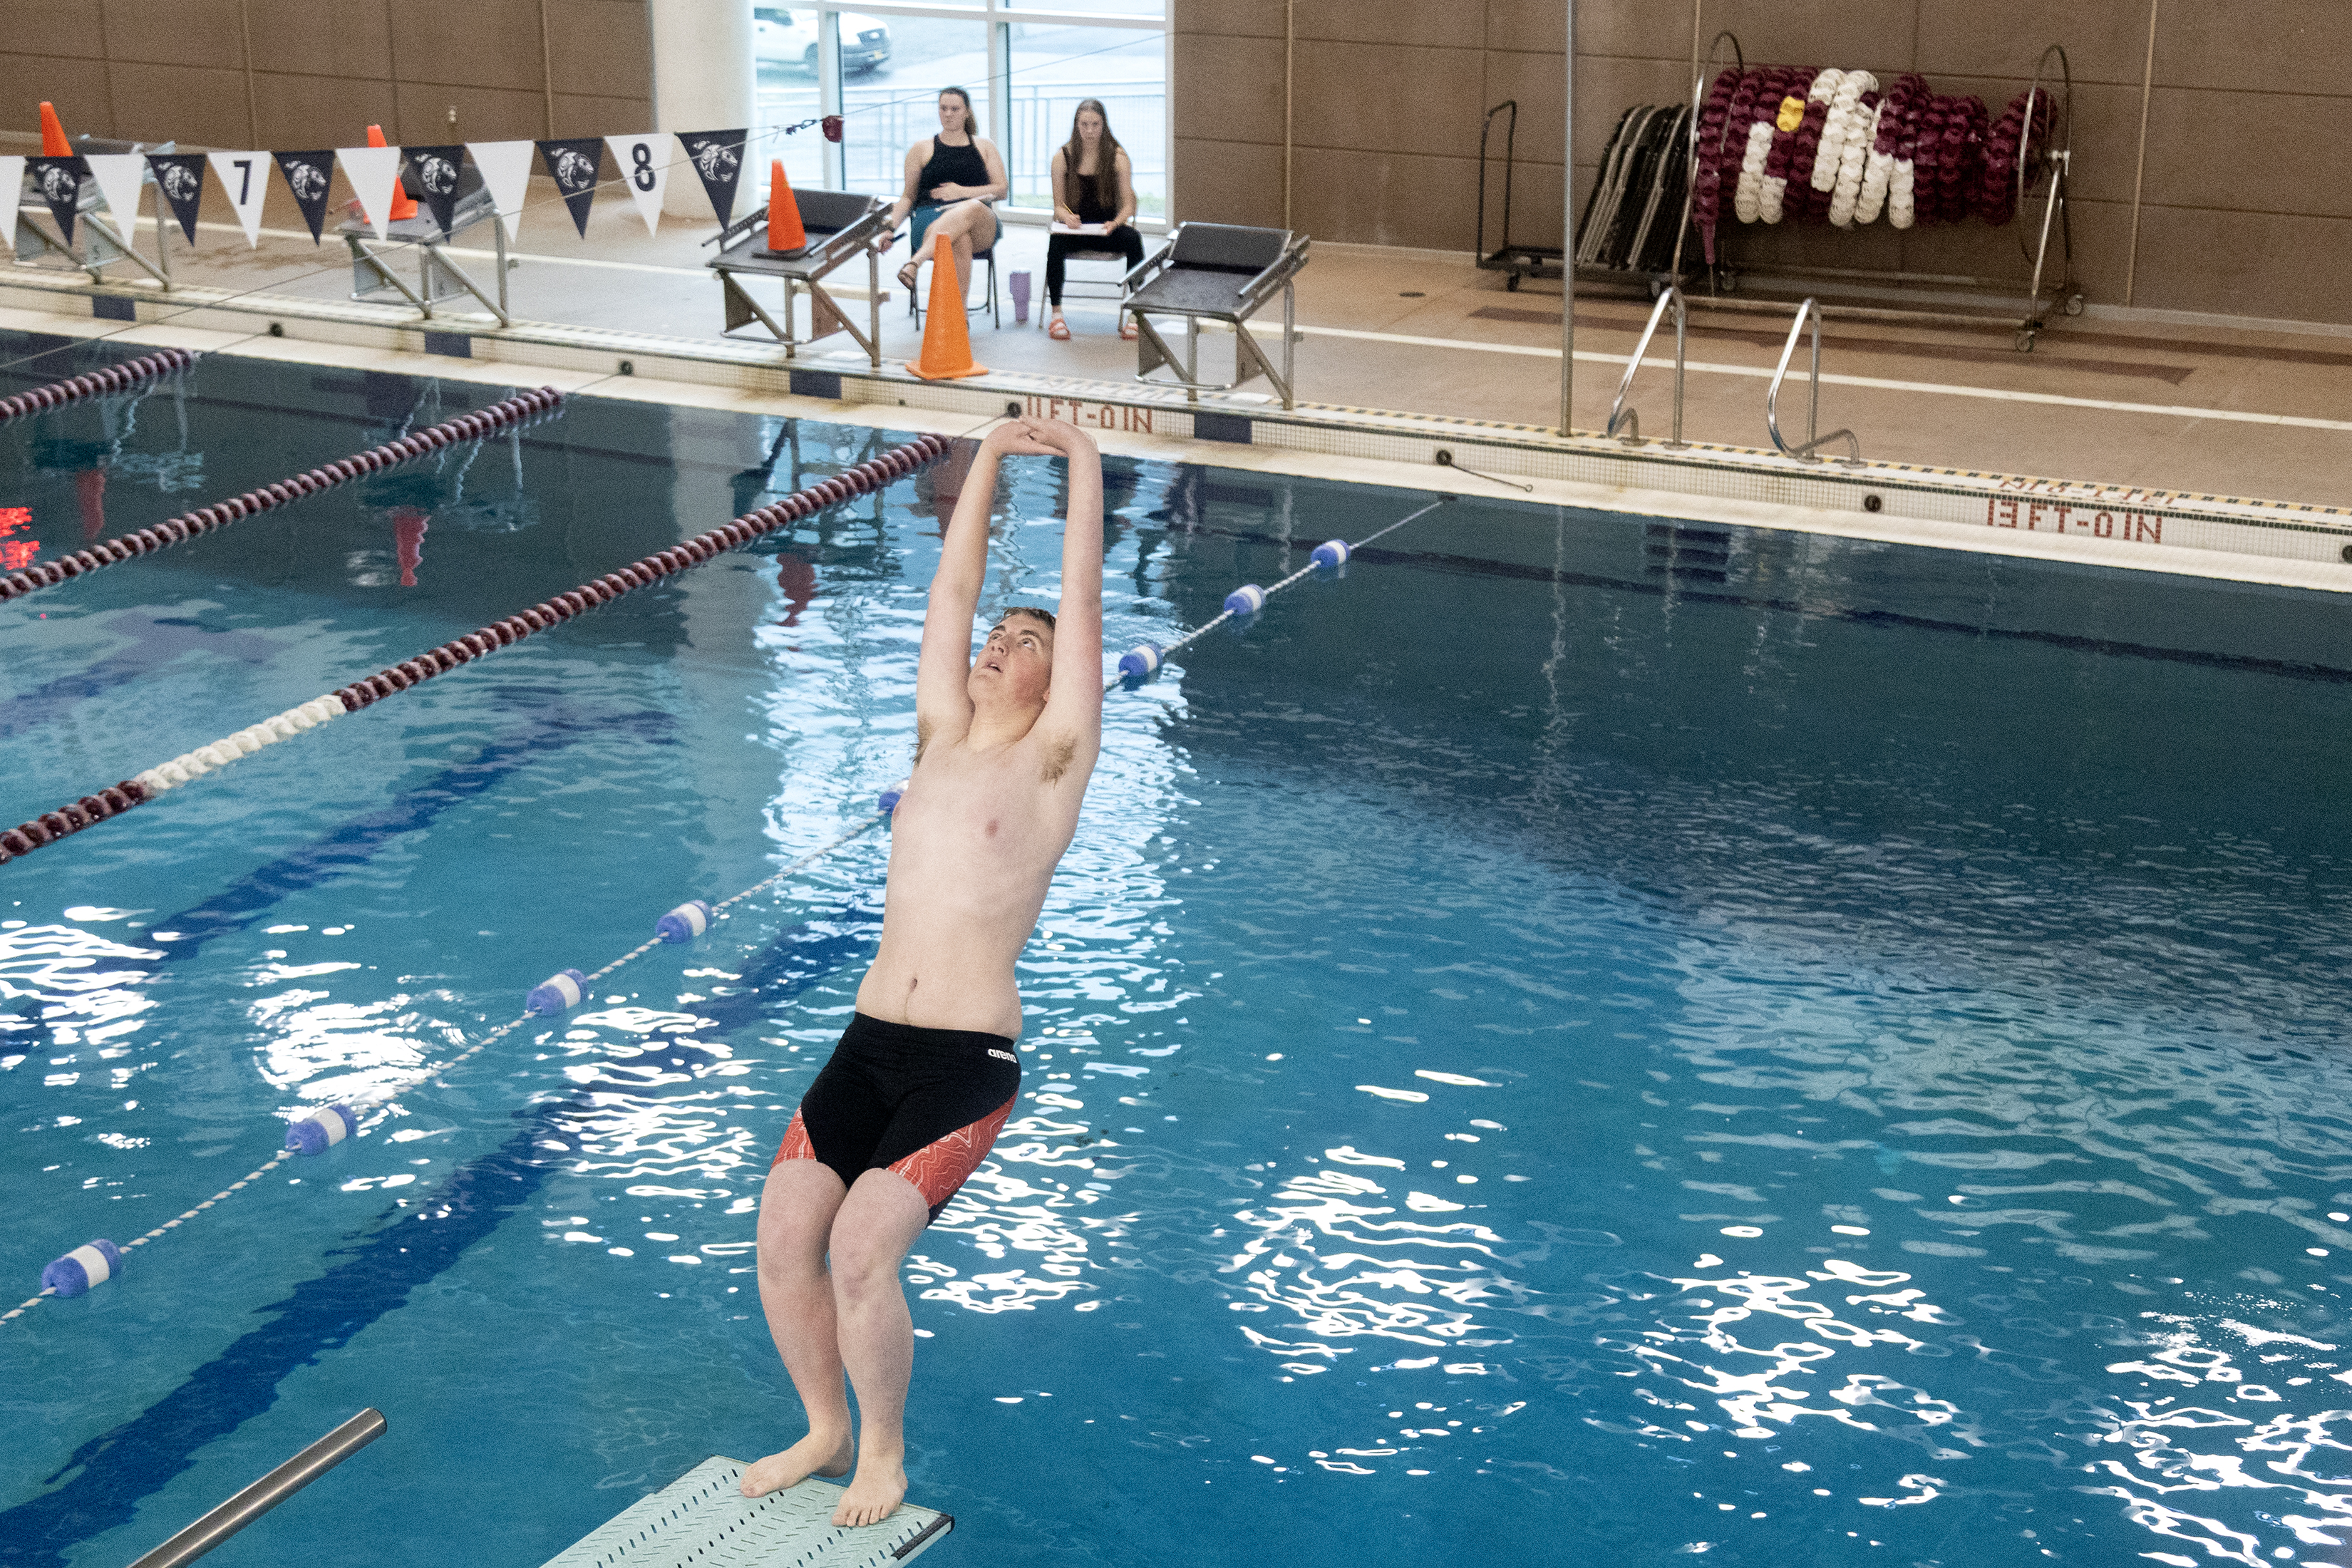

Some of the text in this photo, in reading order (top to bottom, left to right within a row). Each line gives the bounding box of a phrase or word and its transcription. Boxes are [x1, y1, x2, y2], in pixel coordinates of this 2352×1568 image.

[233, 160, 252, 205] 7
[632, 143, 656, 192] 8
[988, 1048, 1017, 1063] arena
